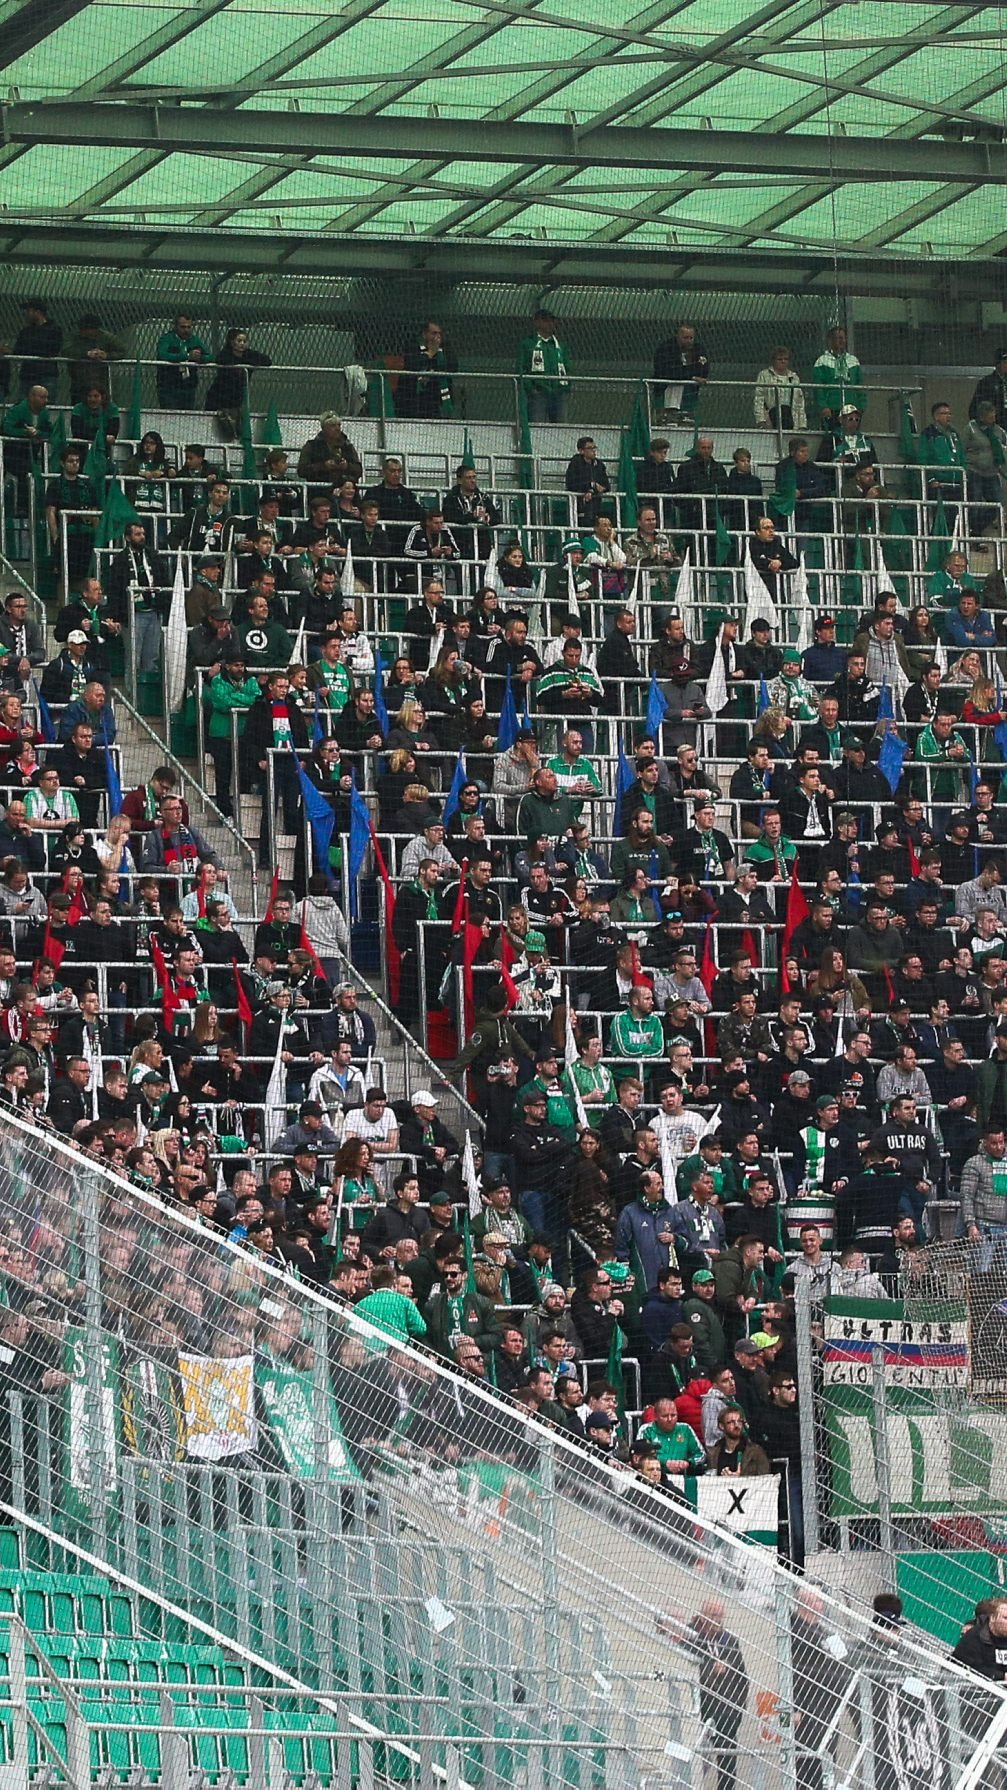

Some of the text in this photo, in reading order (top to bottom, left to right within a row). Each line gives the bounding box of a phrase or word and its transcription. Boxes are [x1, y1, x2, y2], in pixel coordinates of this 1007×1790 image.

[886, 1134, 927, 1150] ULTRAS
[843, 1318, 952, 1343] ULTRAS
[726, 1488, 749, 1515] X
